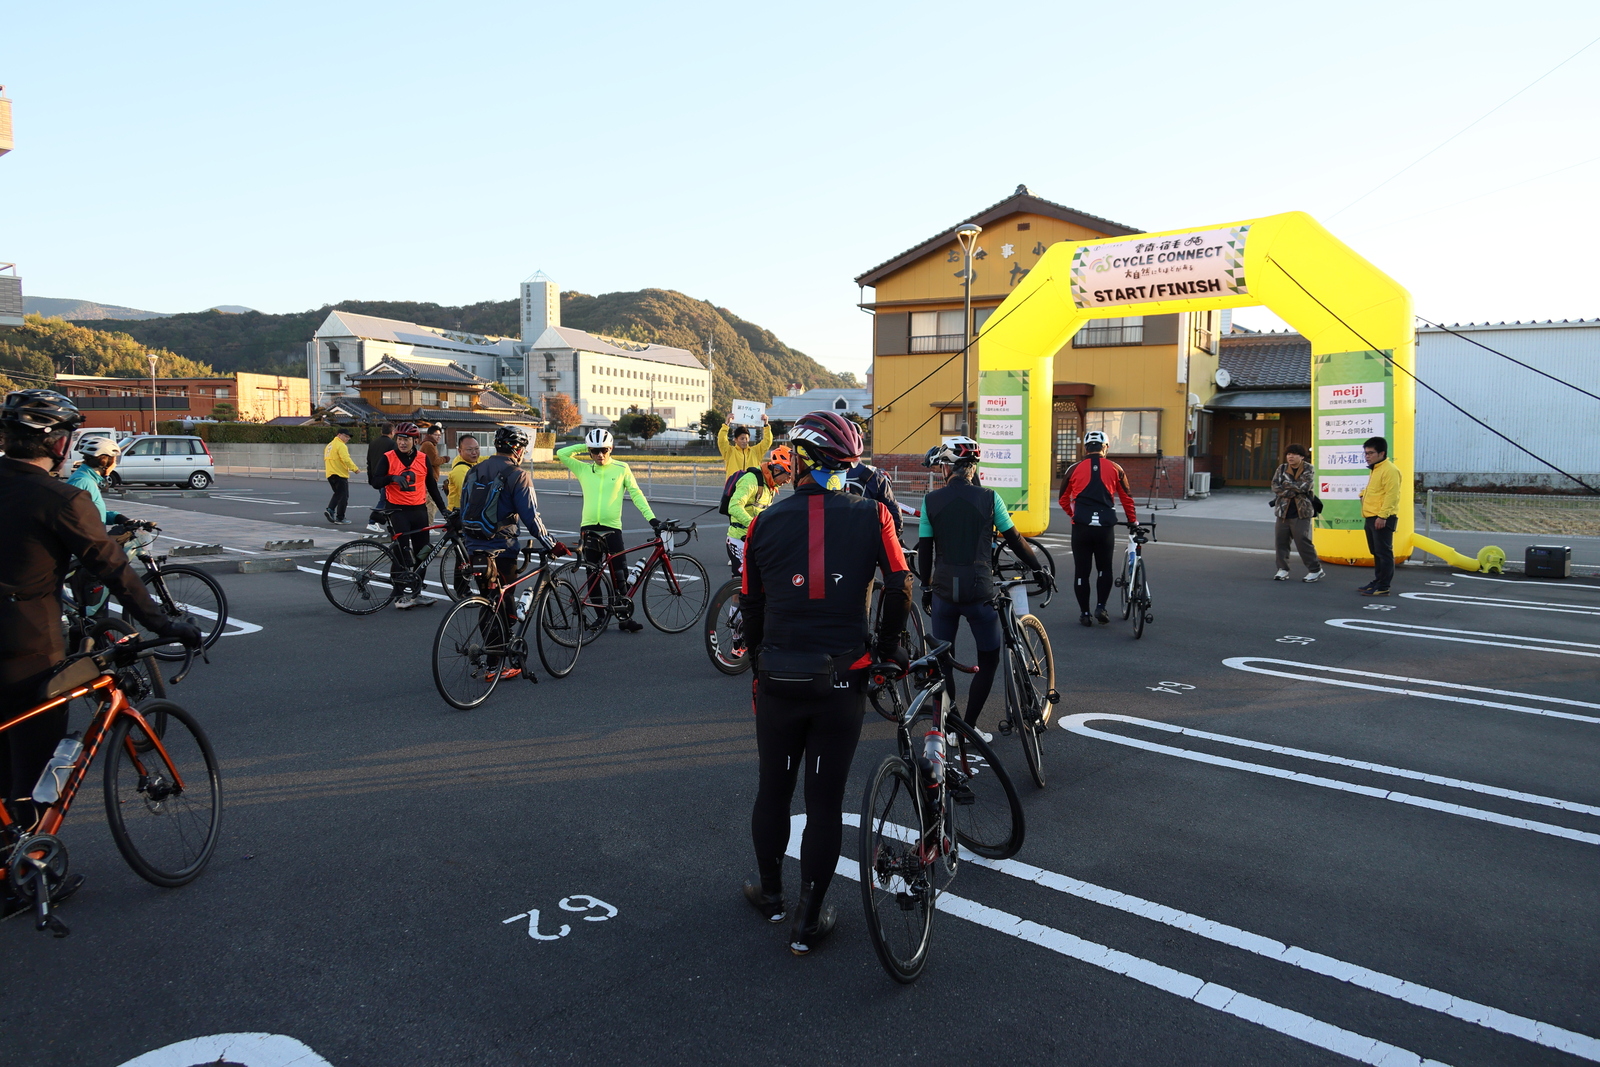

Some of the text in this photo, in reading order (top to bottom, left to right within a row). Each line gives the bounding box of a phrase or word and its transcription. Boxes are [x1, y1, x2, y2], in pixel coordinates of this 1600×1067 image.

[1113, 246, 1223, 269] CYCLE CONNECT
[1124, 265, 1193, 280] 大自然にもほどがある
[1333, 386, 1363, 397] meiji
[986, 397, 1007, 407] meiji
[1326, 427, 1374, 435] ファーム合同会社
